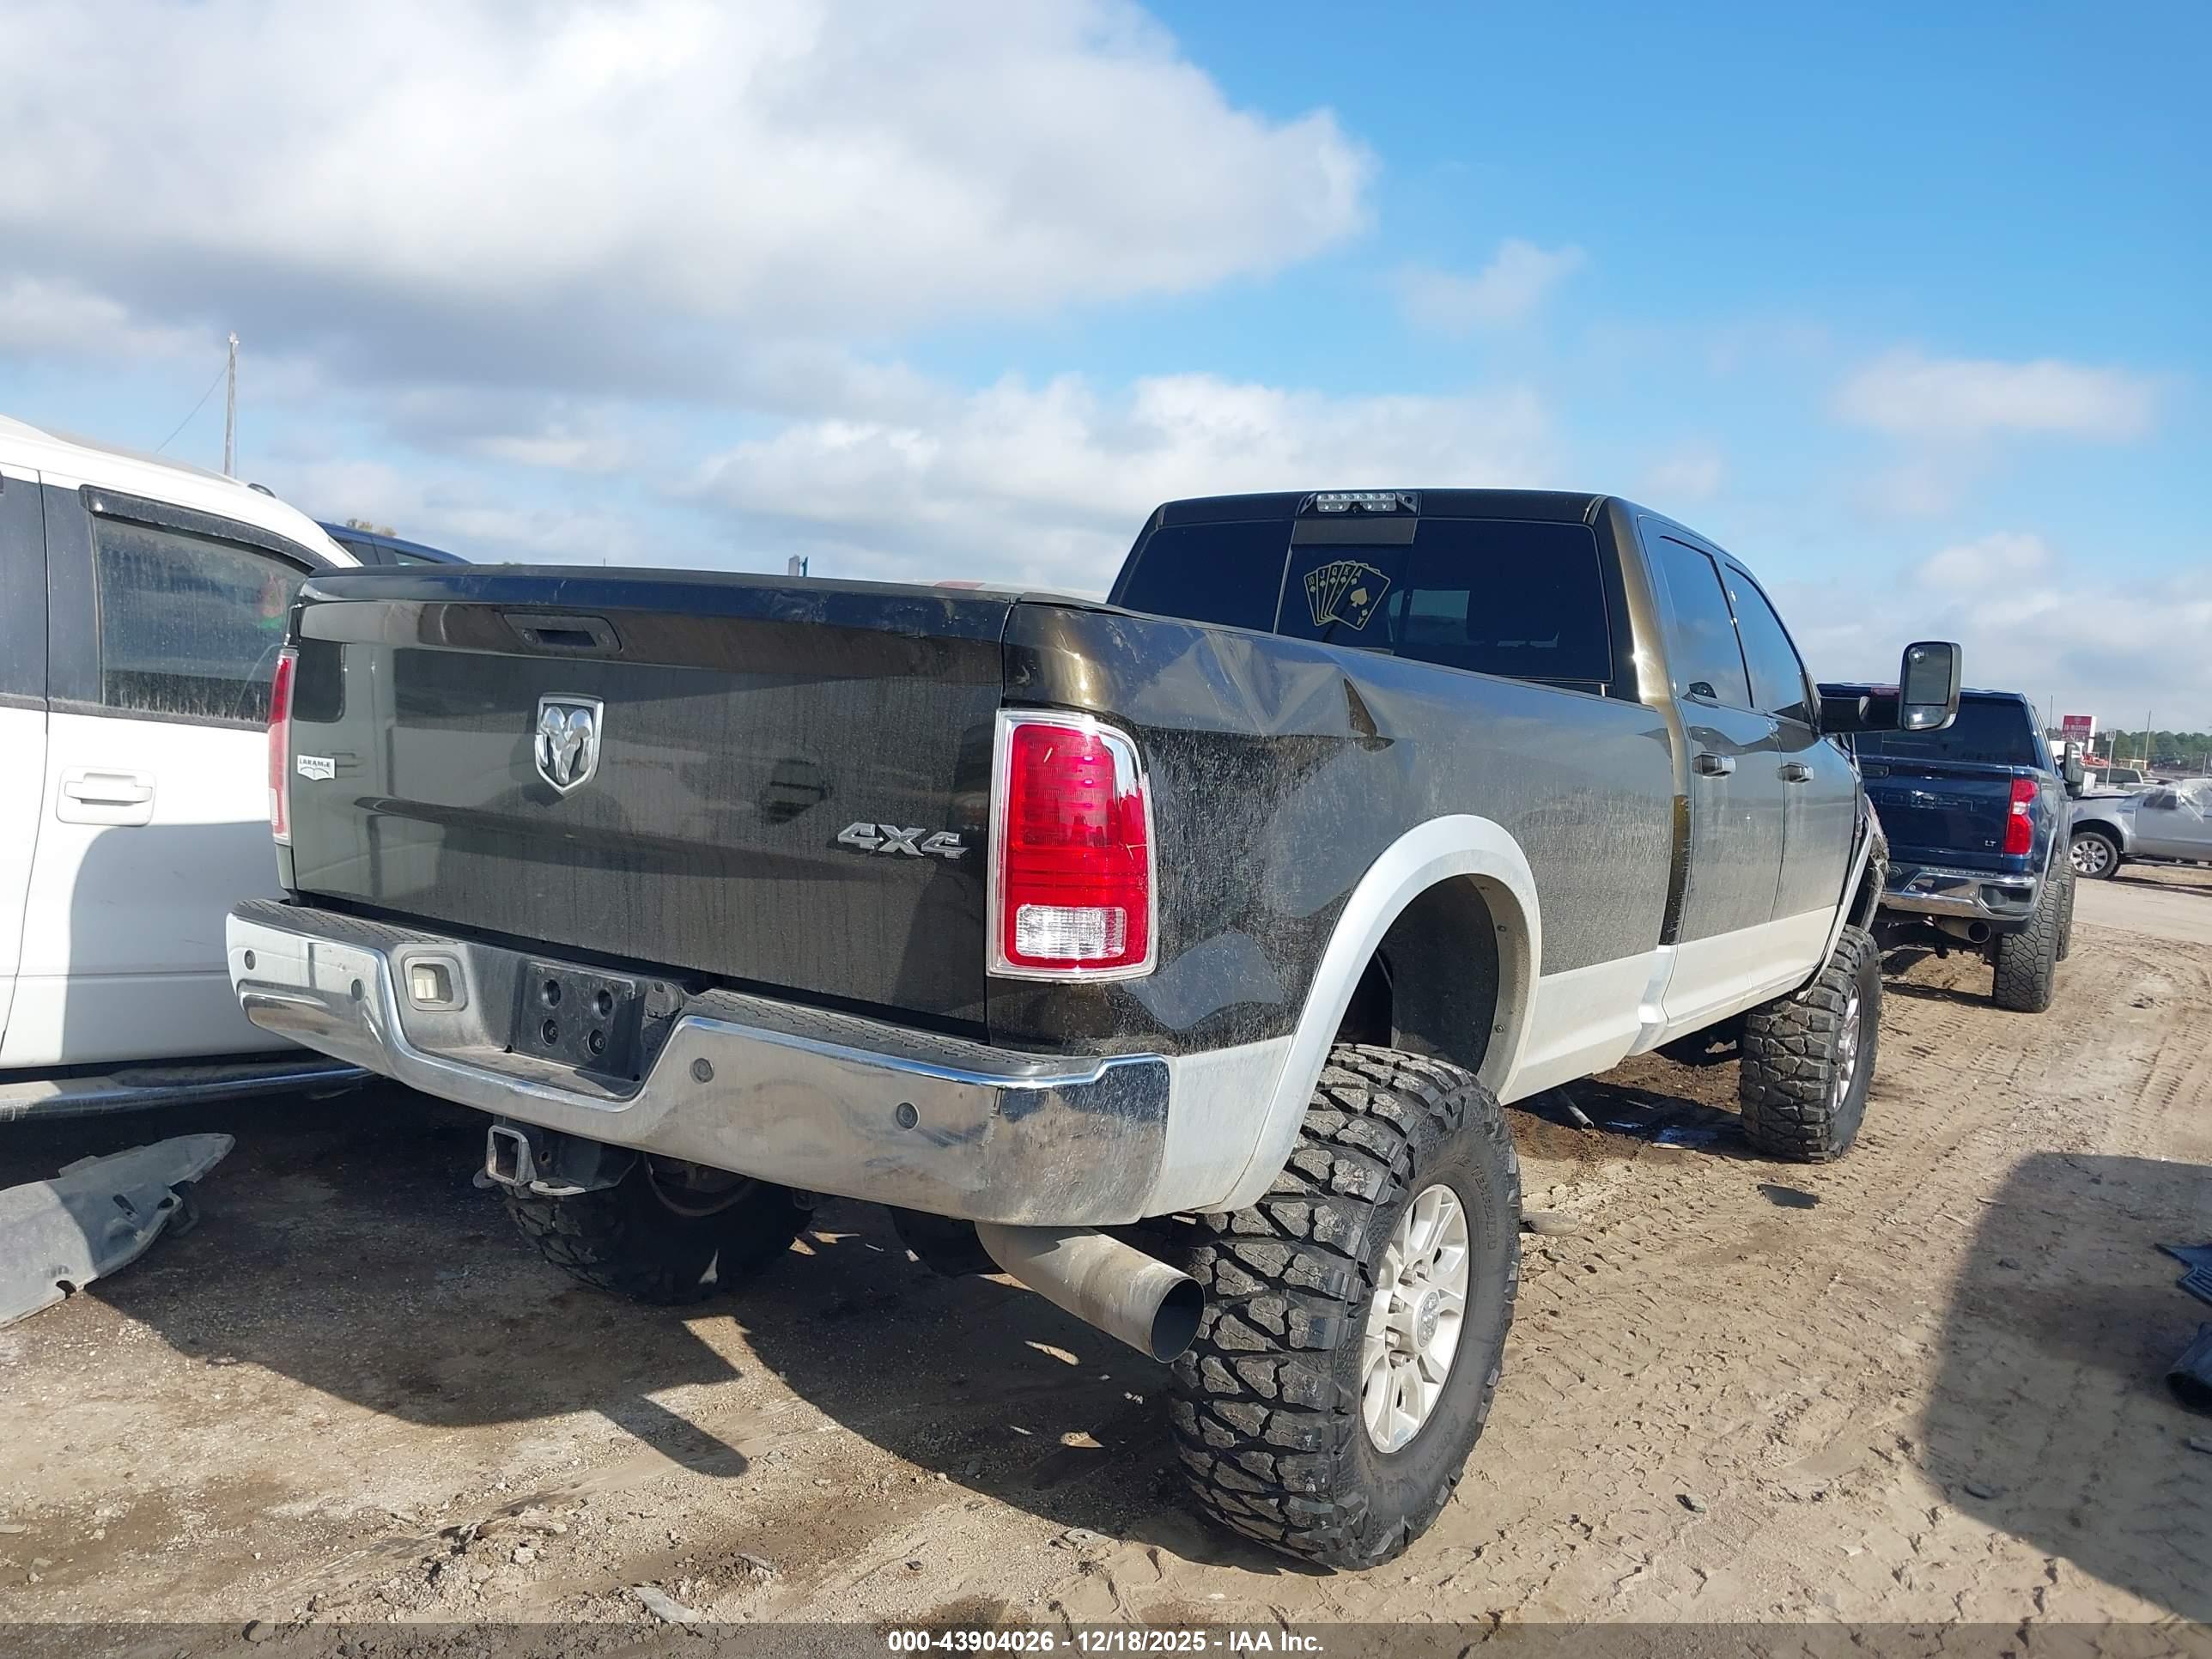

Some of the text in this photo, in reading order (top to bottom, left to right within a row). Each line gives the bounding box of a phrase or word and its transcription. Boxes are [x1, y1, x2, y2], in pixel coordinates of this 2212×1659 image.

[1308, 566, 1362, 586] 10 J Q K A
